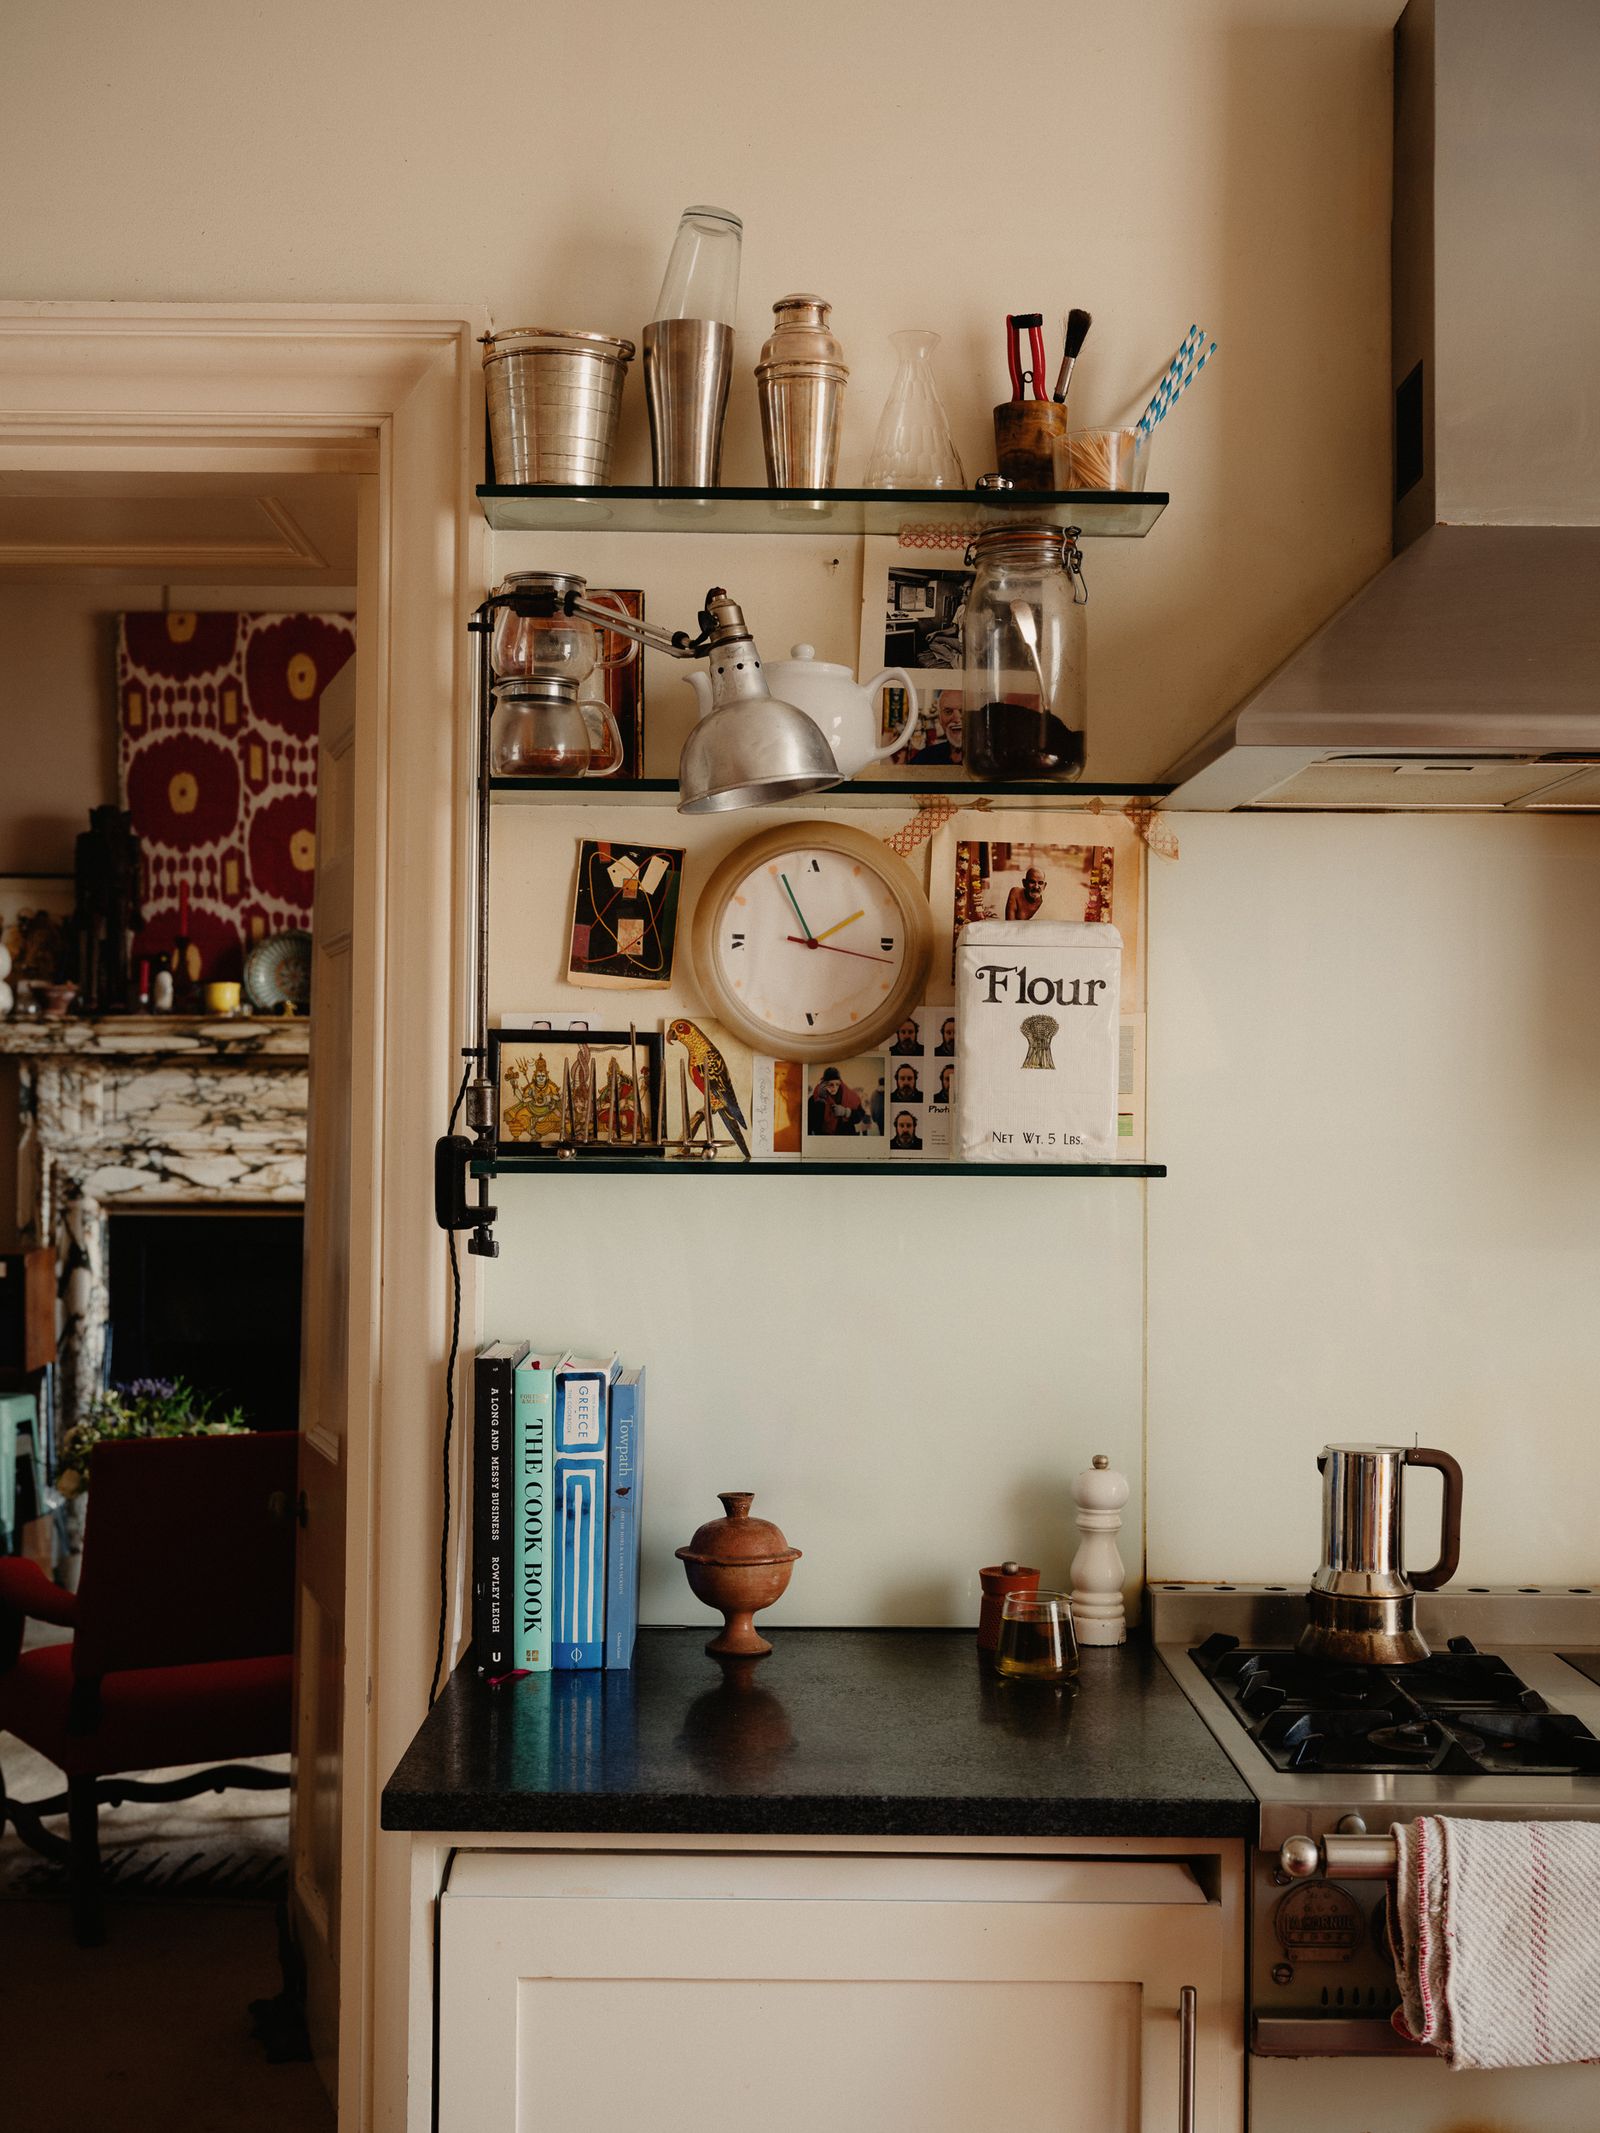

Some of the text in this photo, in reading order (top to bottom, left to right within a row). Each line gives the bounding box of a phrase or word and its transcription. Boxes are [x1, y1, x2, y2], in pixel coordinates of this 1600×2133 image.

[975, 965, 1107, 1007] Flour
[992, 1131, 1084, 1145] NET WT. 5 LBS.
[491, 1398, 499, 1425] LONG
[578, 1386, 588, 1437] GREECE
[491, 1429, 499, 1450] AND
[616, 1415, 633, 1476] Towpath
[491, 1457, 500, 1489] MESSY
[491, 1493, 500, 1540] BUSINESS
[524, 1419, 543, 1635] THE COOK BOOK
[492, 1557, 500, 1599] ROWLEY
[492, 1602, 500, 1632] LEIGH
